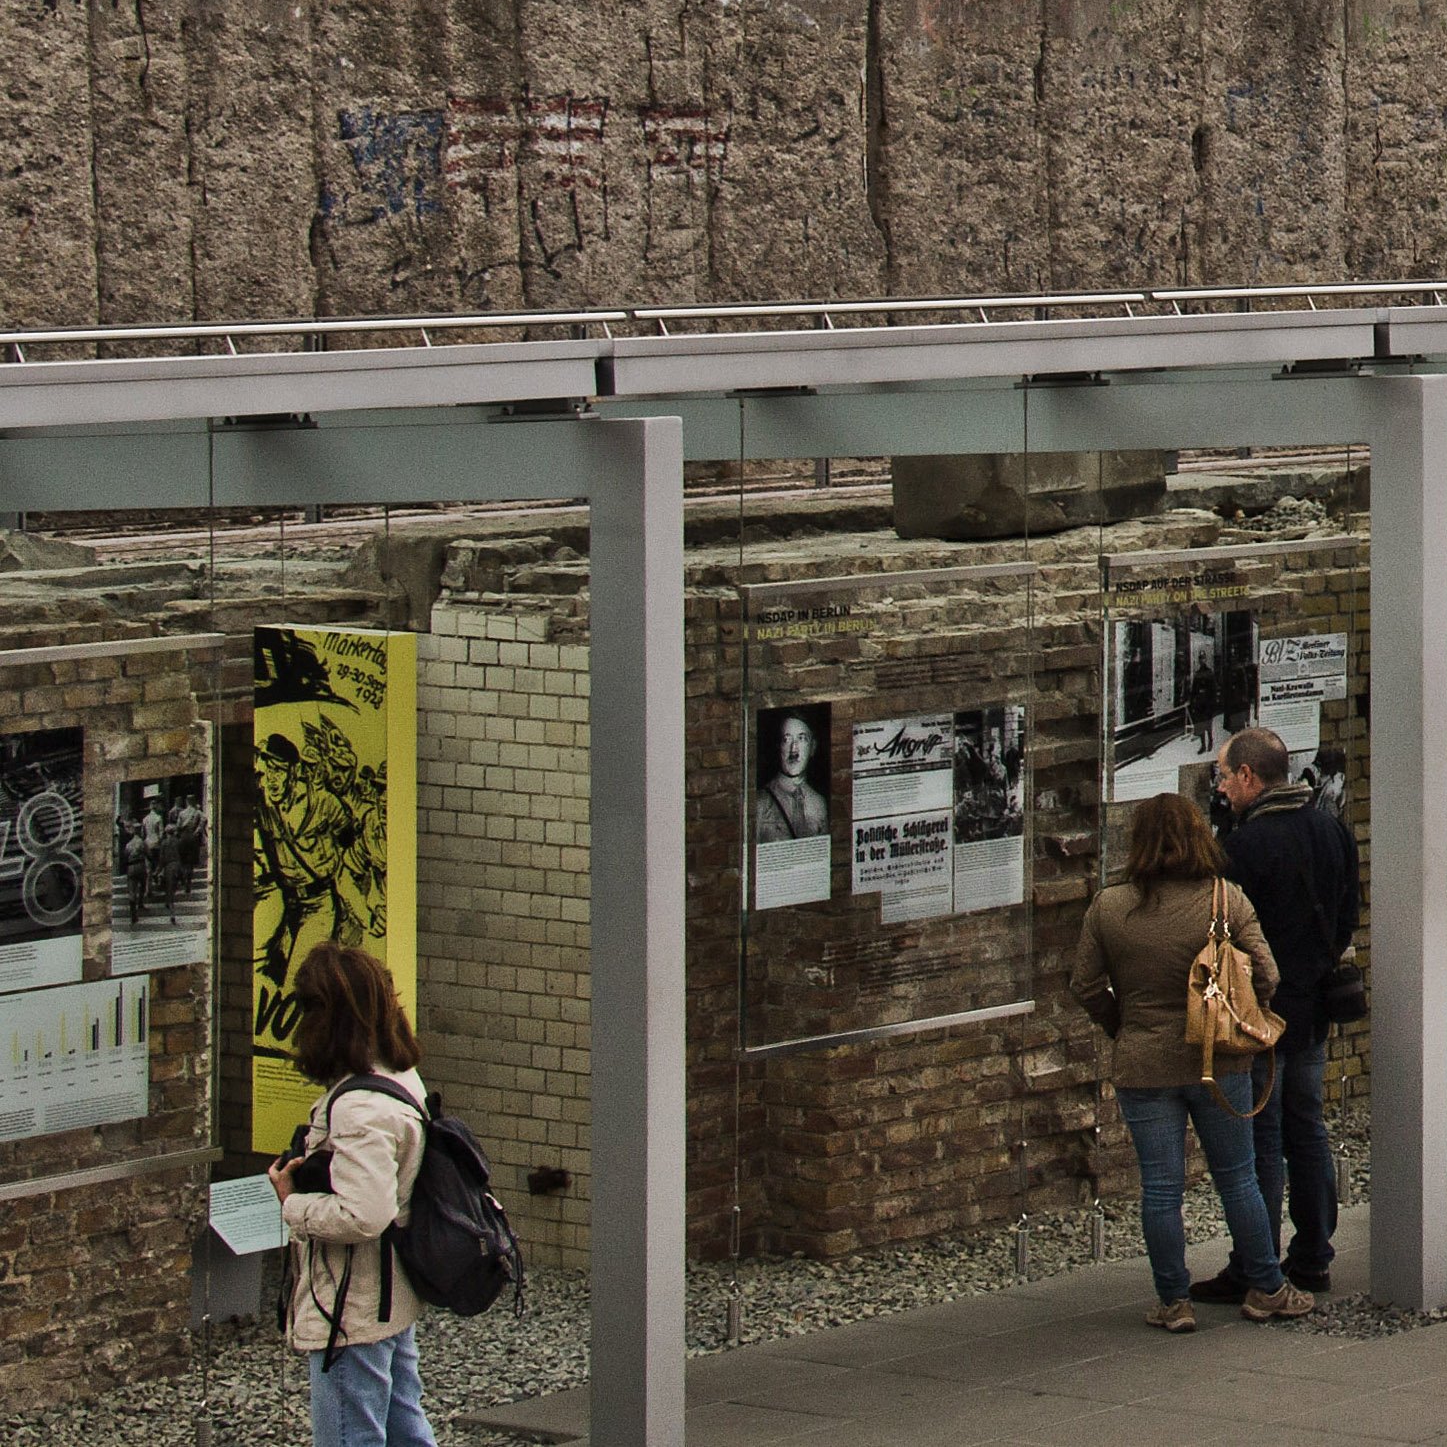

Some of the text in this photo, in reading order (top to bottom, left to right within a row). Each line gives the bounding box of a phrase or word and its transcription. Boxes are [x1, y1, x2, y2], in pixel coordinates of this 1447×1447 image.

[1115, 580, 1149, 593] NSDAP
[1151, 577, 1170, 590] AUF
[1172, 576, 1192, 589] DER
[1115, 594, 1140, 608] NAZI
[1174, 589, 1188, 603] ON
[1210, 585, 1251, 599] STREETS
[756, 605, 851, 625] NSDAP IN BERLIN
[757, 618, 877, 641] NAZI PARTY IN BERLIN
[254, 985, 302, 1042] VO
